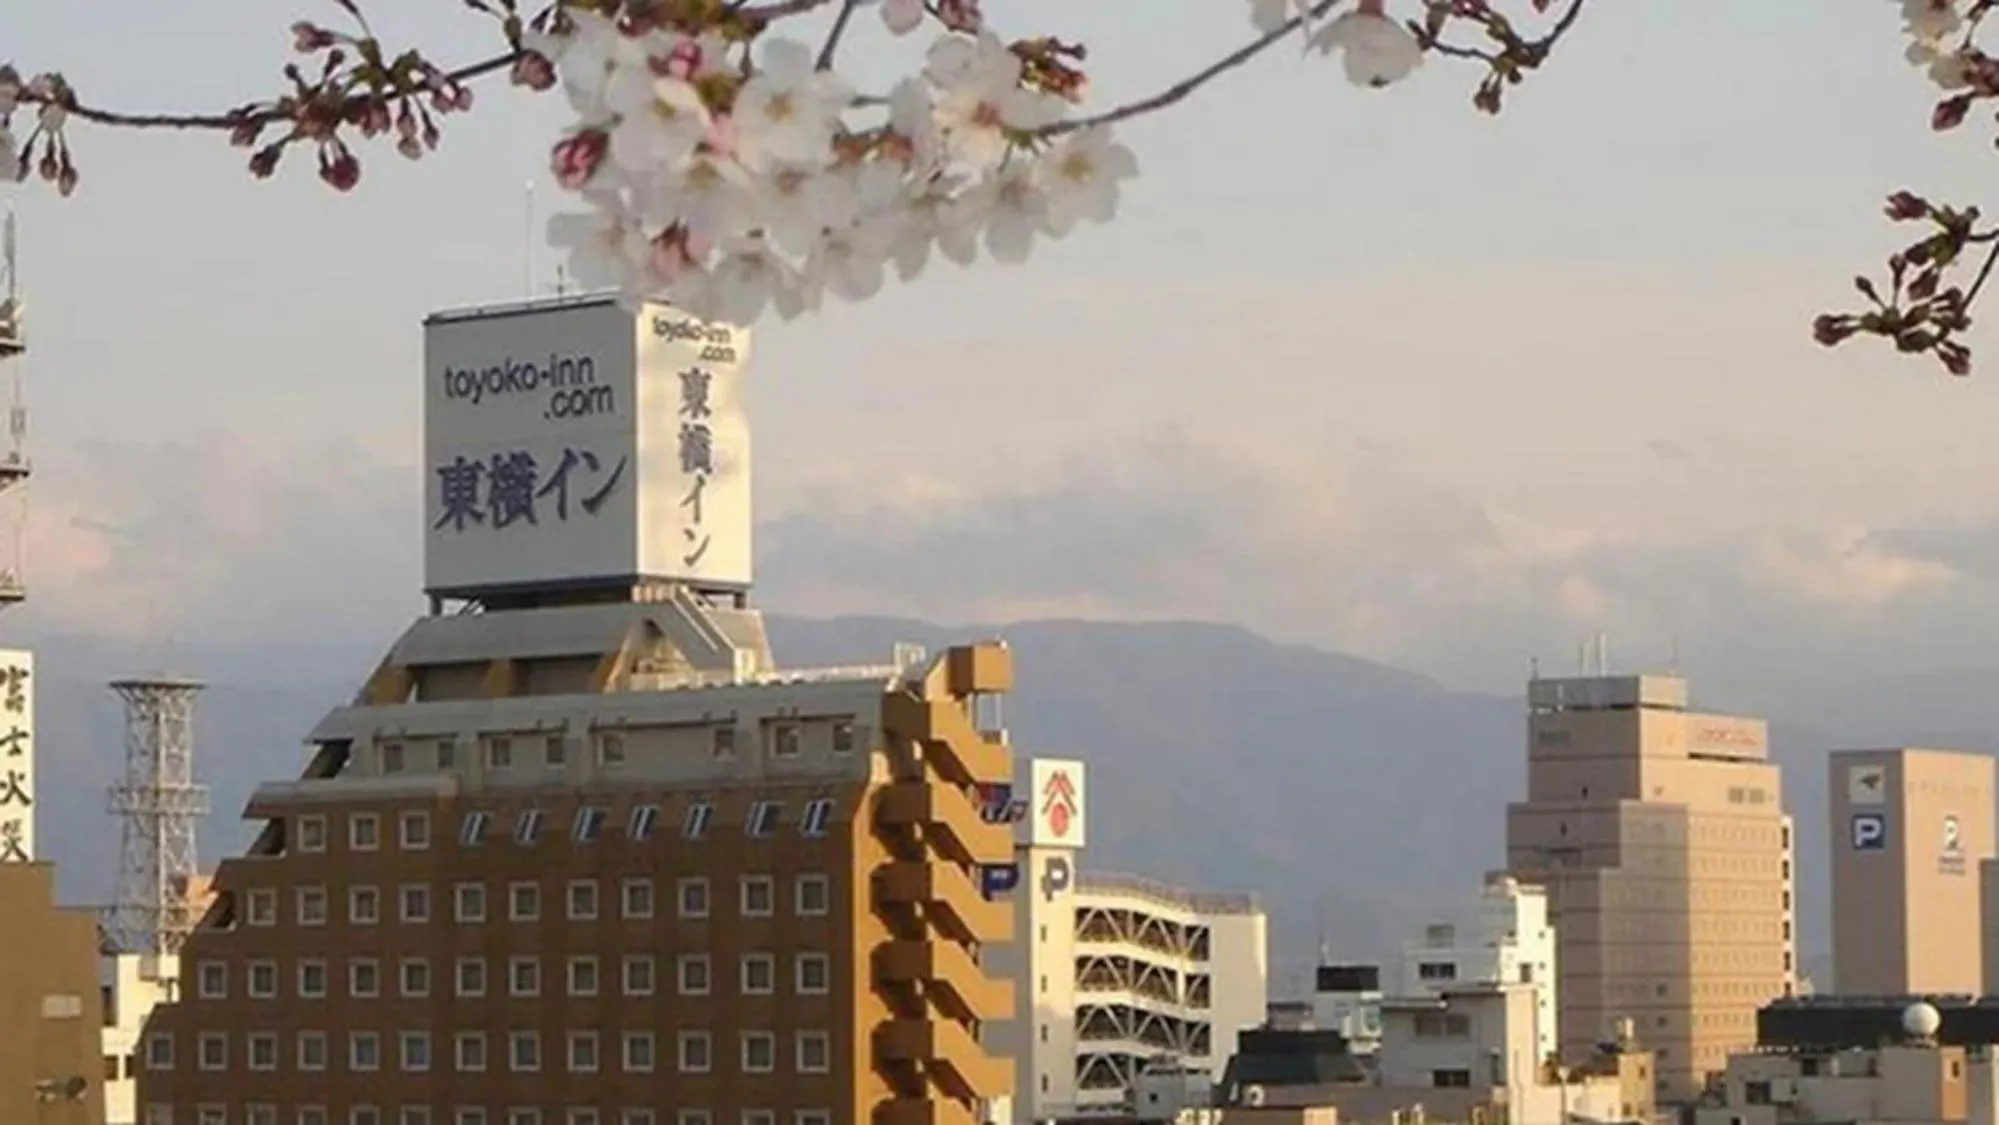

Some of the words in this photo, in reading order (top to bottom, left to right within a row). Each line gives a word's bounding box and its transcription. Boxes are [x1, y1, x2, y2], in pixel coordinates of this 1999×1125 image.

[544, 383, 614, 420] .com
[433, 447, 628, 532] 東横イン
[677, 366, 712, 568] 東横イン
[1855, 817, 1882, 847] P
